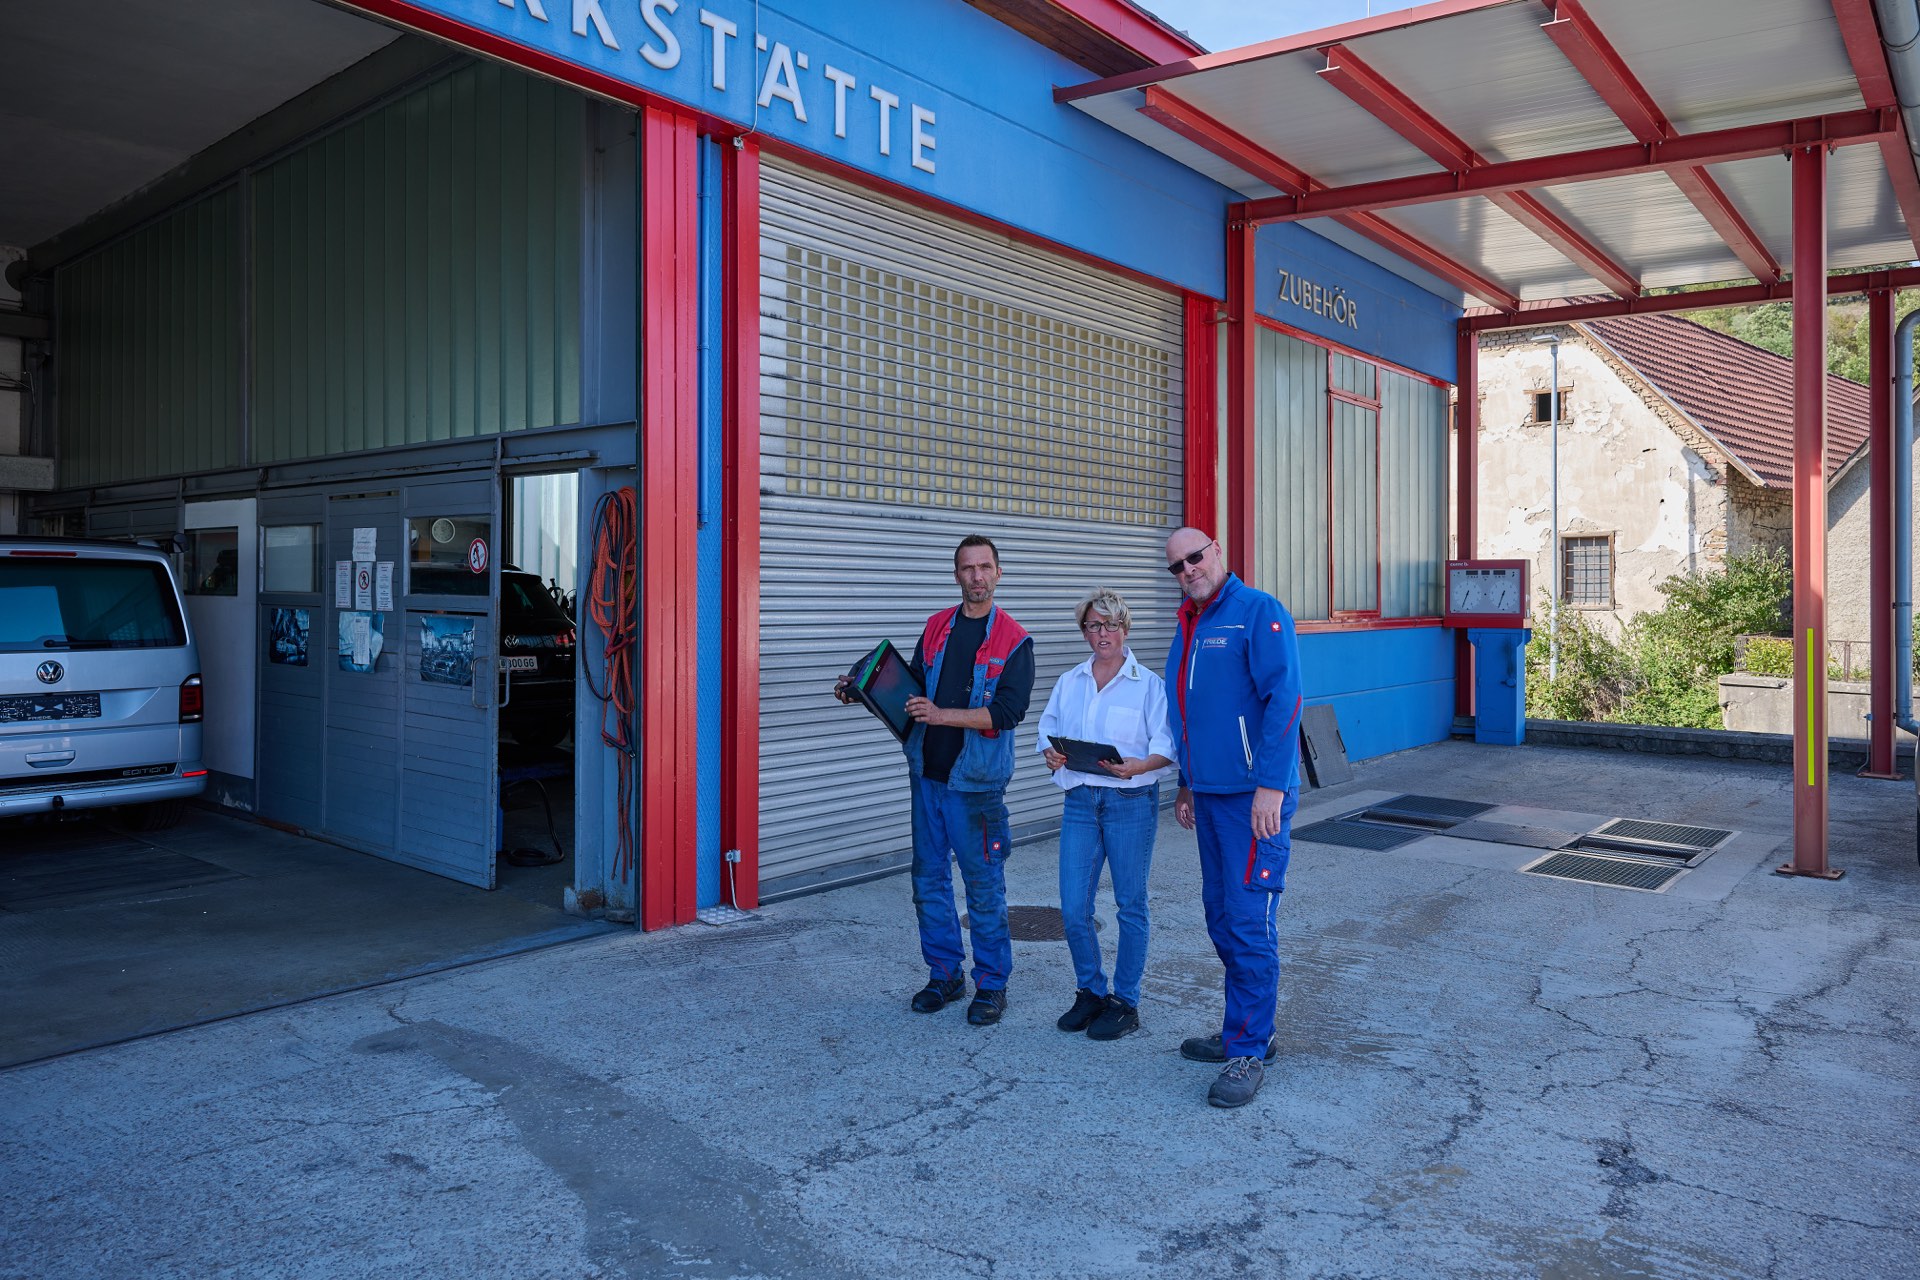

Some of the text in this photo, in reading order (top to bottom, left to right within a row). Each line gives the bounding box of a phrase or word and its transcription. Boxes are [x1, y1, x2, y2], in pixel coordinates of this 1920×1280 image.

[497, 0, 937, 174] KSTÄTTE
[1278, 268, 1358, 330] ZUBEHÖR
[122, 766, 168, 776] EDITION
